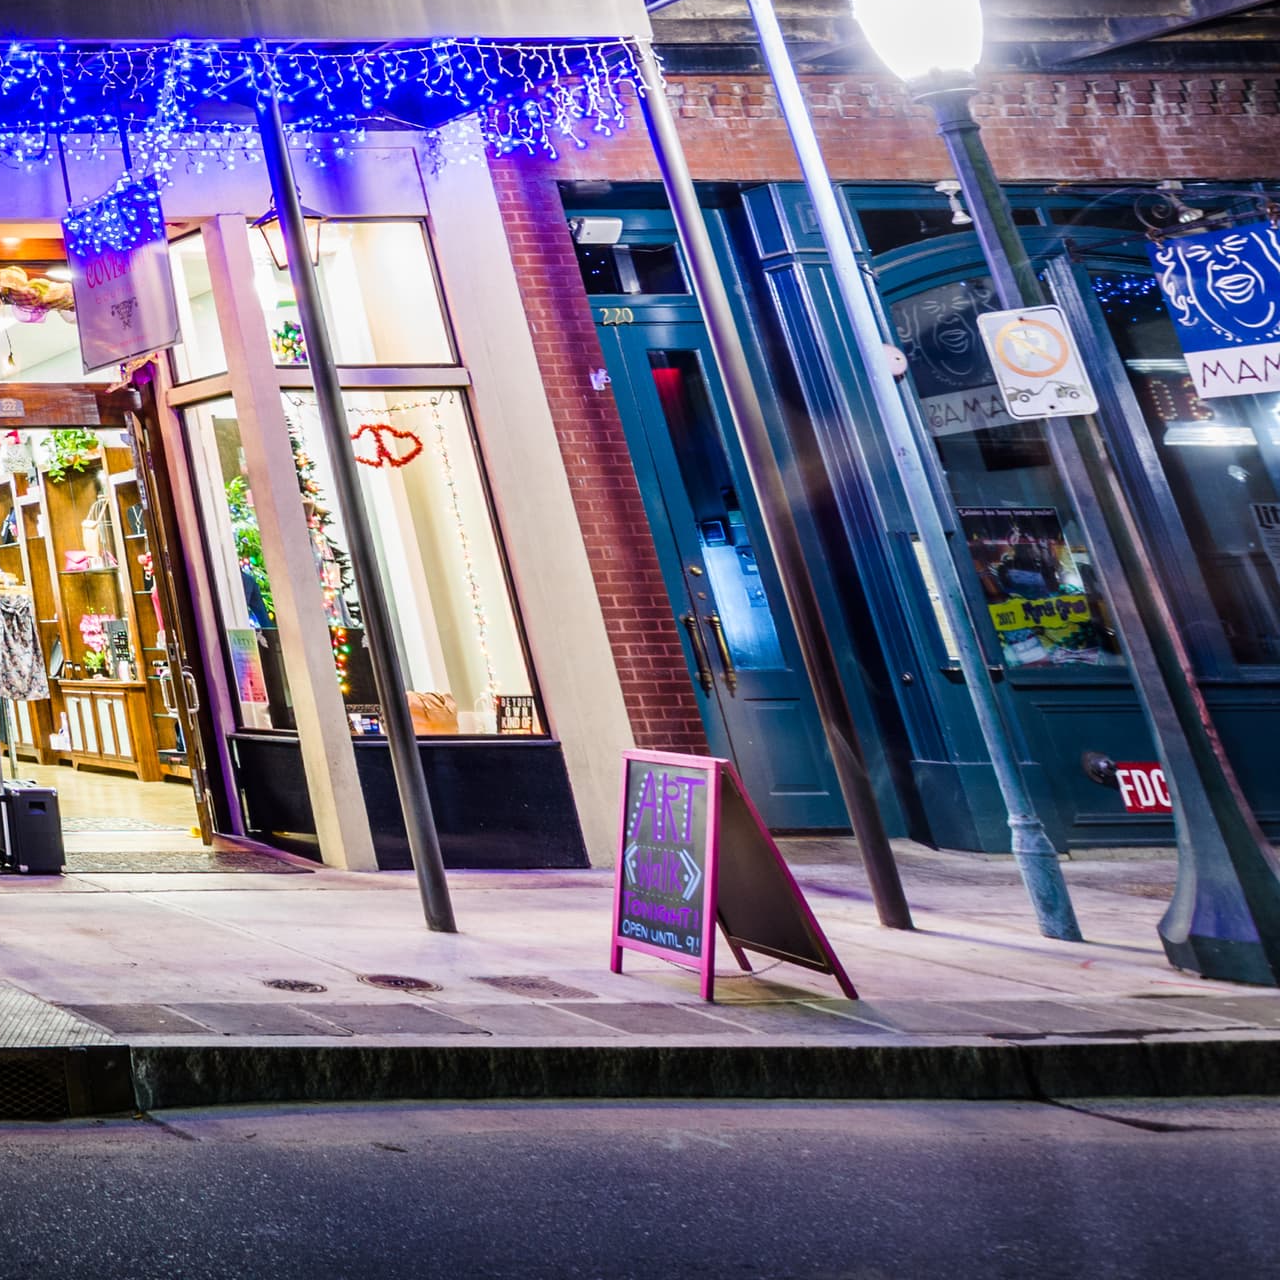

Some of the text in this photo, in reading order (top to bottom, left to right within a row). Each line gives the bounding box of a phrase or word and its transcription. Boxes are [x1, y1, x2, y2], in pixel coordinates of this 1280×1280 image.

[599, 307, 634, 325] 220
[996, 599, 1087, 627] 2017 Mardi Gras
[505, 706, 529, 717] OWN
[1116, 769, 1172, 807] FDC
[631, 771, 706, 843] ART
[622, 920, 700, 953] OPEN UNTIL 9!
